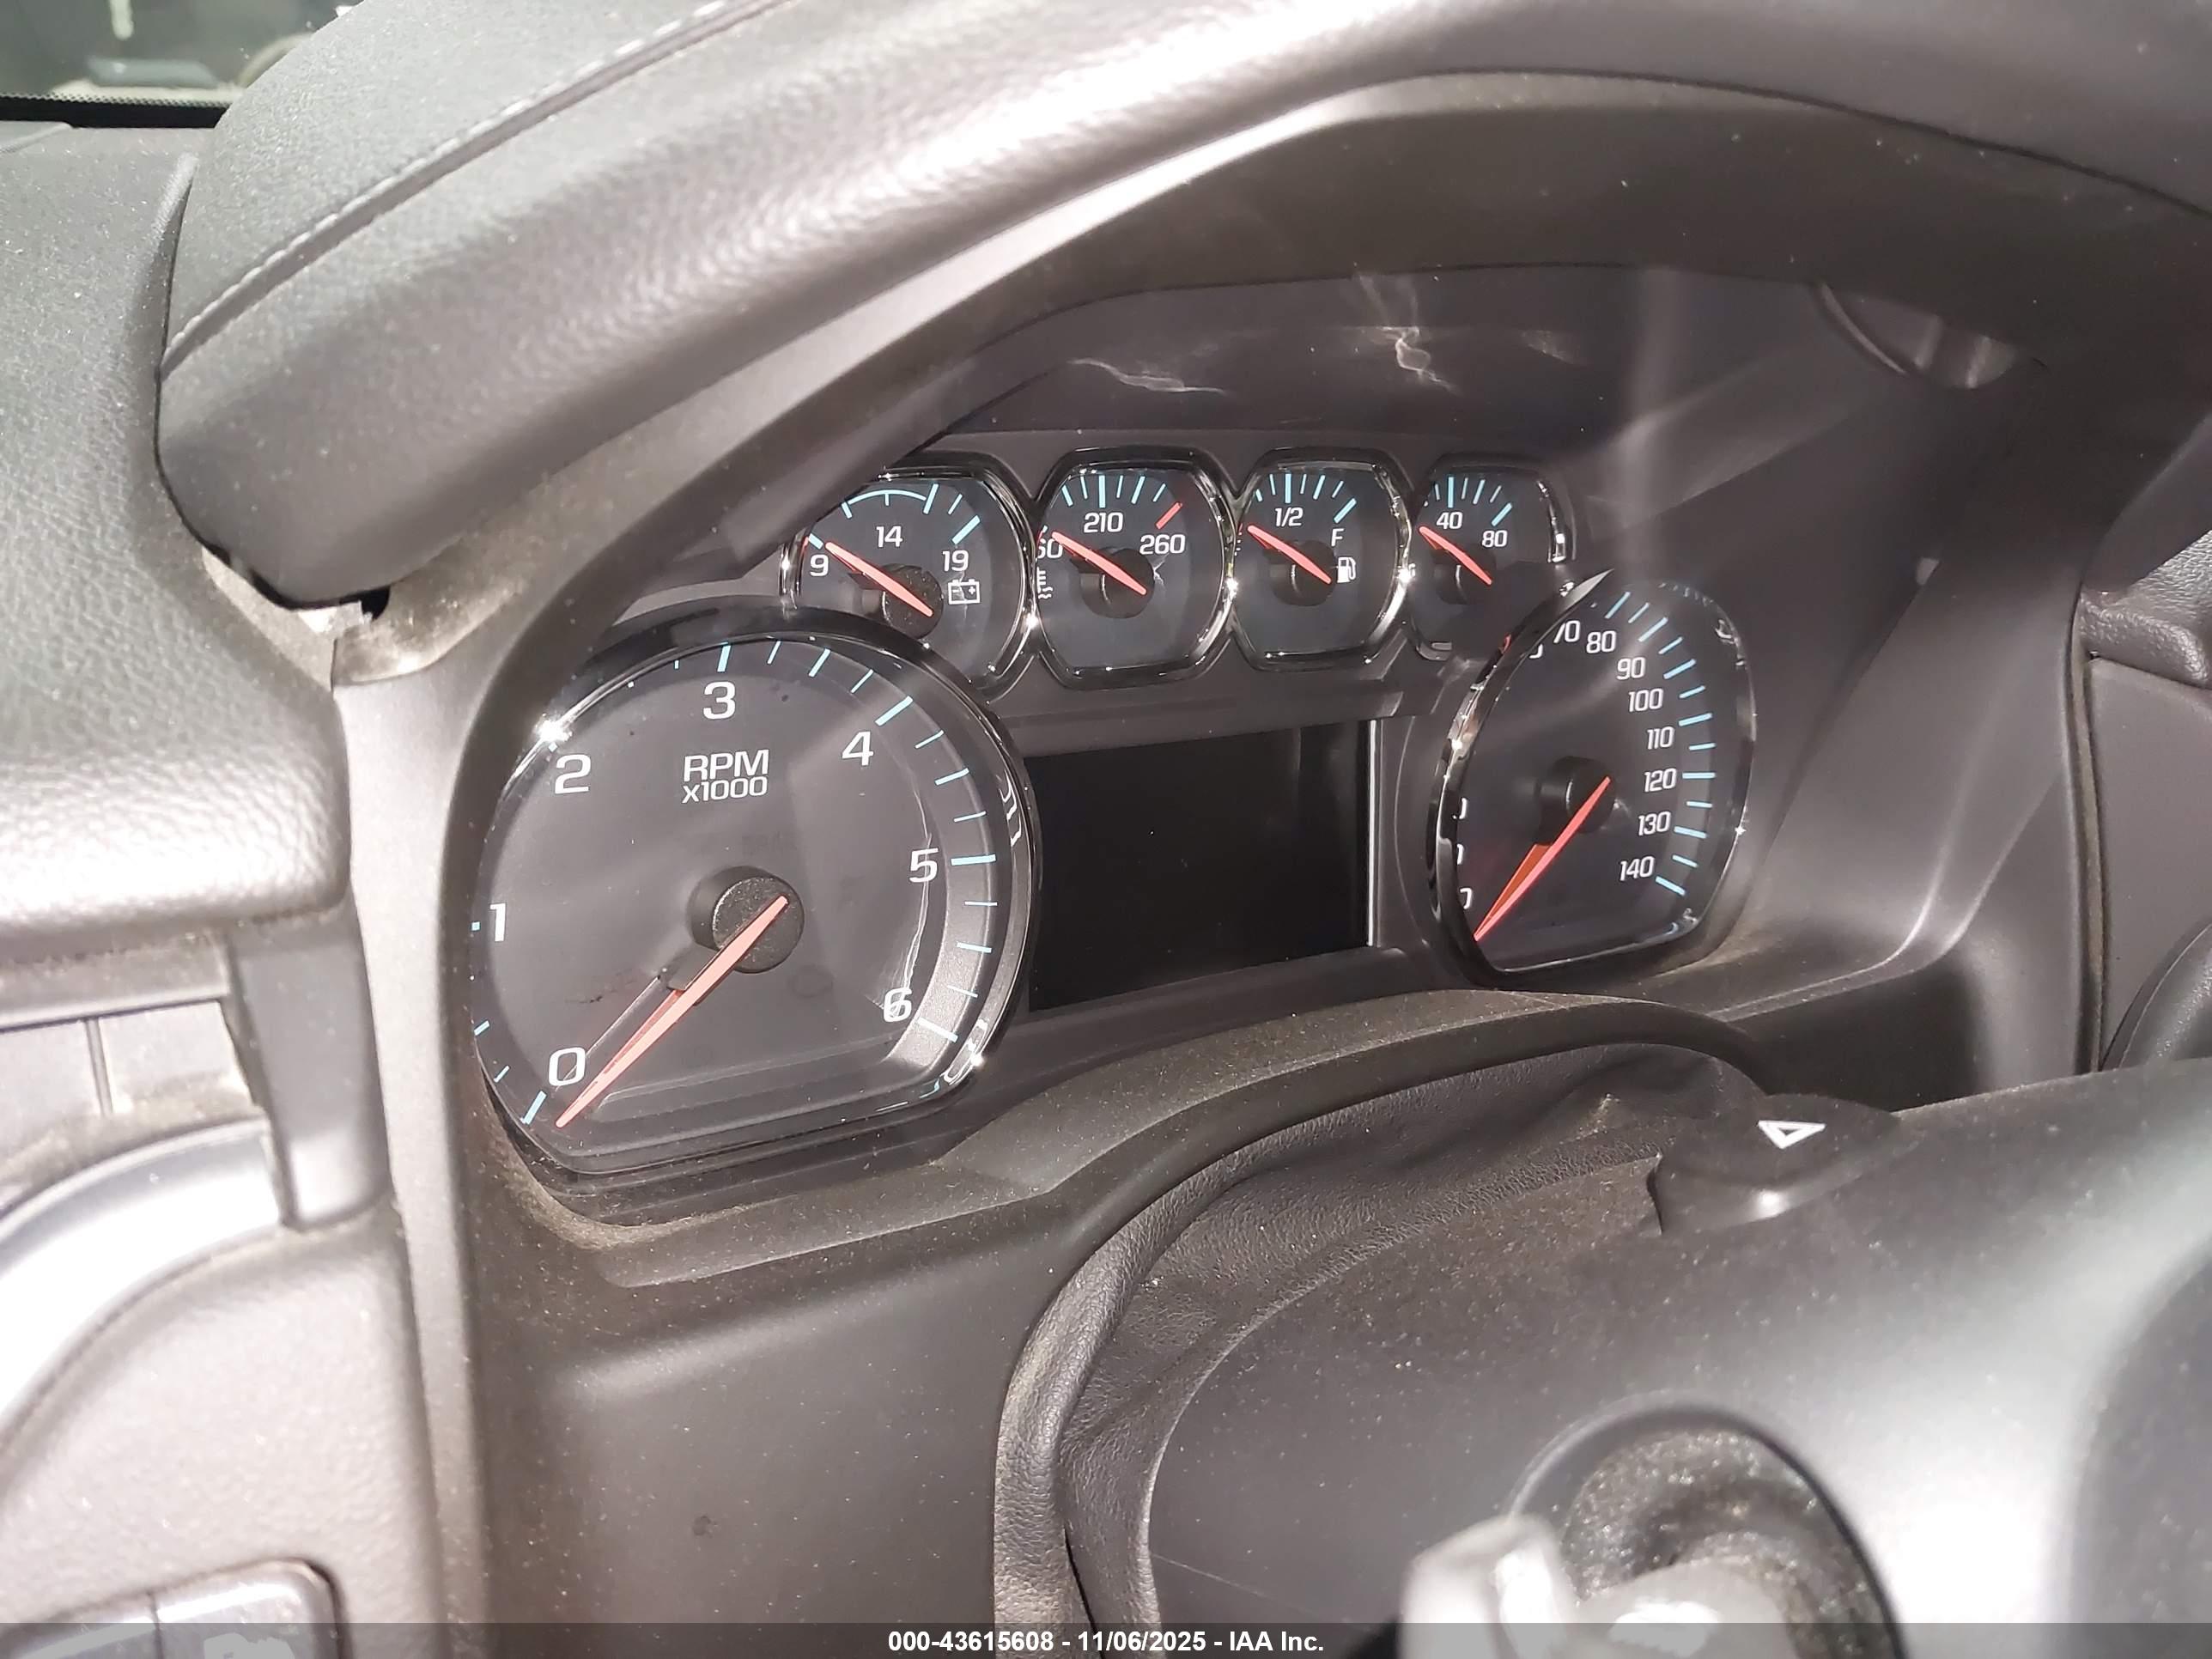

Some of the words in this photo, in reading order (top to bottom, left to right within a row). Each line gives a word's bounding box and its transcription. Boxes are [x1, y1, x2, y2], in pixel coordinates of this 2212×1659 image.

[1084, 512, 1123, 533] 210
[1274, 507, 1304, 527] 1/2
[1436, 512, 1462, 530] 40
[876, 526, 902, 548] 14
[1139, 534, 1186, 555] 260
[1331, 528, 1345, 547] F
[1481, 530, 1508, 548] 80
[810, 554, 830, 577] 9
[942, 550, 969, 572] 19
[1586, 630, 1616, 653] 80
[1617, 656, 1645, 680] 90
[702, 681, 736, 720] 3
[1628, 688, 1663, 713] 100
[842, 731, 874, 766] 4
[1647, 726, 1674, 750] 110
[554, 753, 592, 794] 2
[684, 749, 769, 782] RPM
[1644, 769, 1677, 792] 120
[1638, 811, 1671, 836] 130
[908, 848, 939, 884] 5
[1620, 856, 1654, 882] 140
[489, 902, 507, 942] 1
[882, 987, 913, 1023] 6
[548, 1047, 586, 1087] 0
